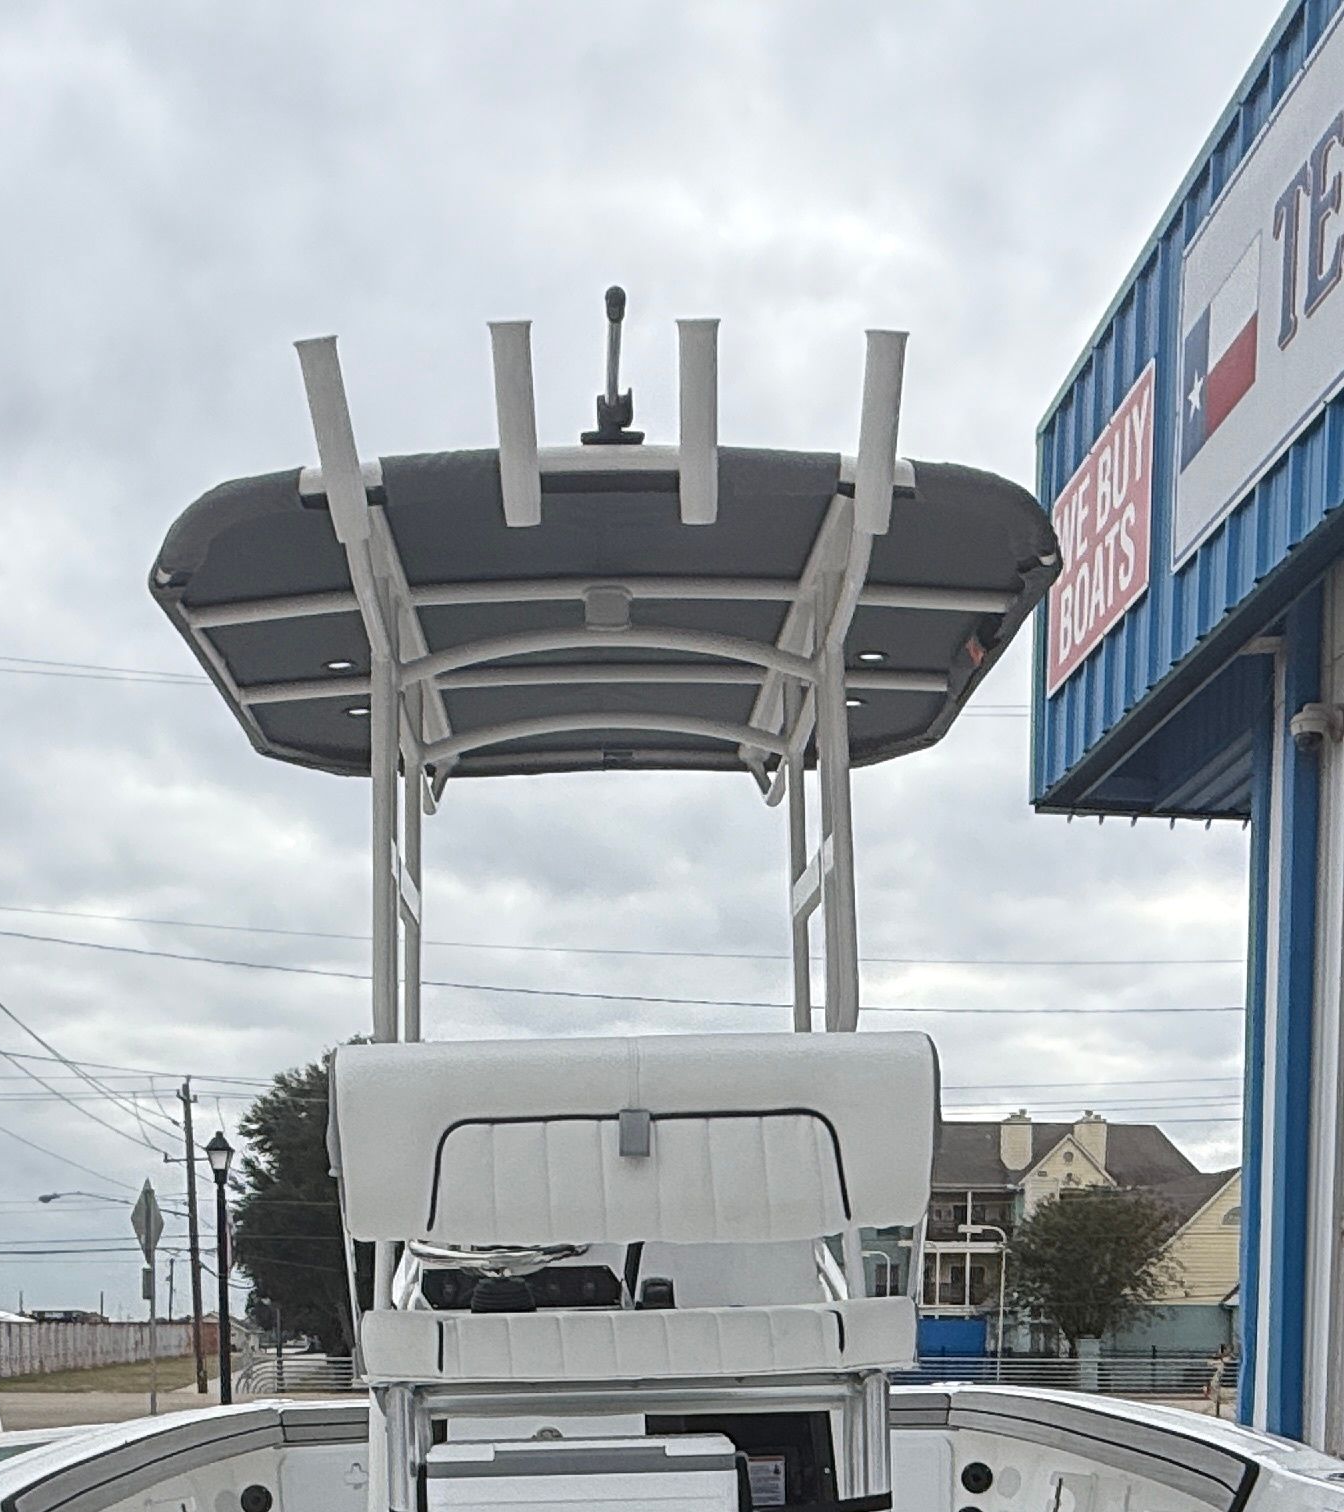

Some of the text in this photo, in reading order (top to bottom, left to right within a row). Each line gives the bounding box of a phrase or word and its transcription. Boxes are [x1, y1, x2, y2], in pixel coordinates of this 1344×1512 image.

[1057, 387, 1150, 579] WE BUY
[1059, 502, 1136, 665] BOATS
